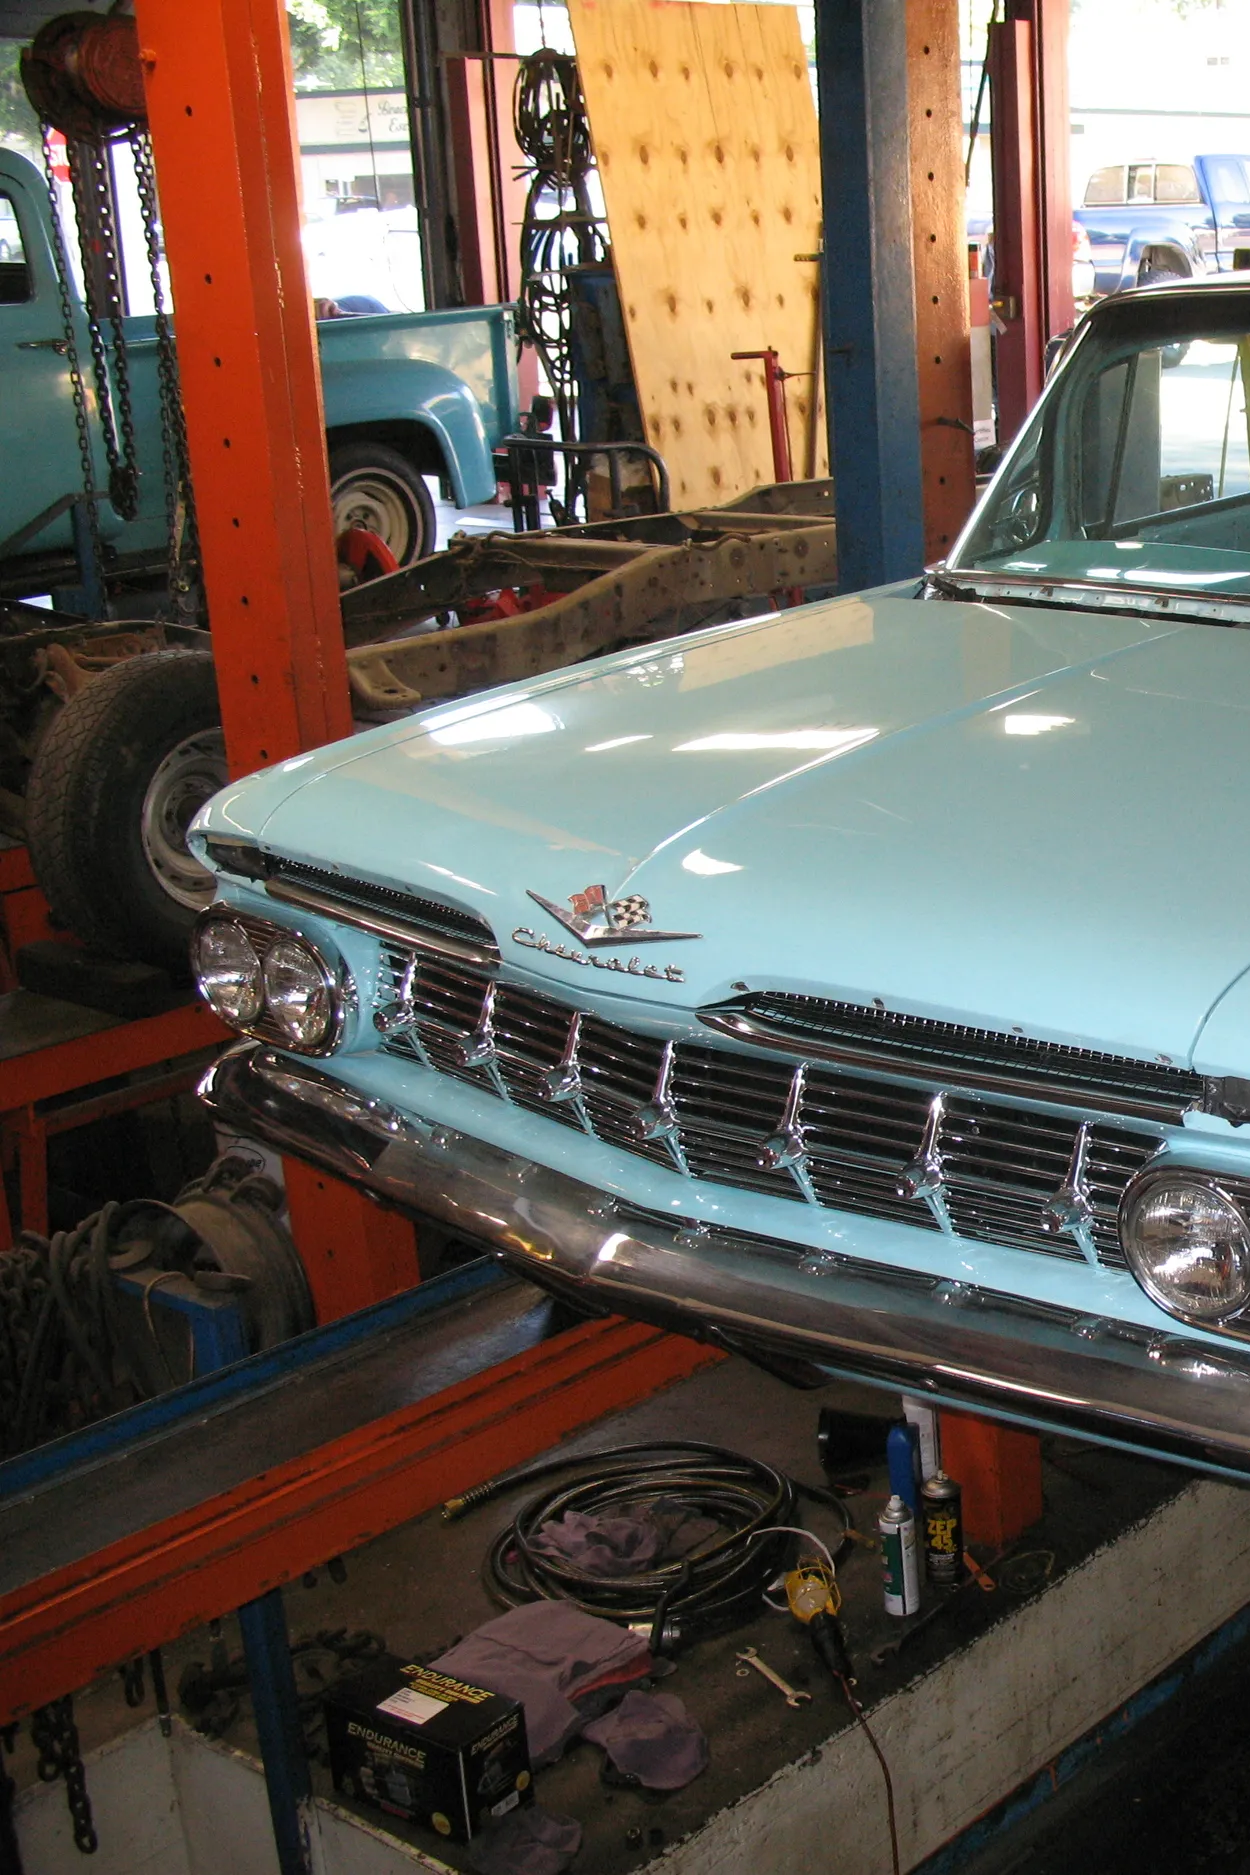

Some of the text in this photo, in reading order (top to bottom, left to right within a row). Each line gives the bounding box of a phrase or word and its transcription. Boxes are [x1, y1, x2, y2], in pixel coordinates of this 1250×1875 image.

[511, 927, 685, 983] Chevrolet
[927, 1518, 957, 1536] ZEP
[400, 1664, 496, 1702] ENDURANCE
[347, 1721, 427, 1764] ENDURANCE
[470, 1713, 520, 1757] ENDURANCE
